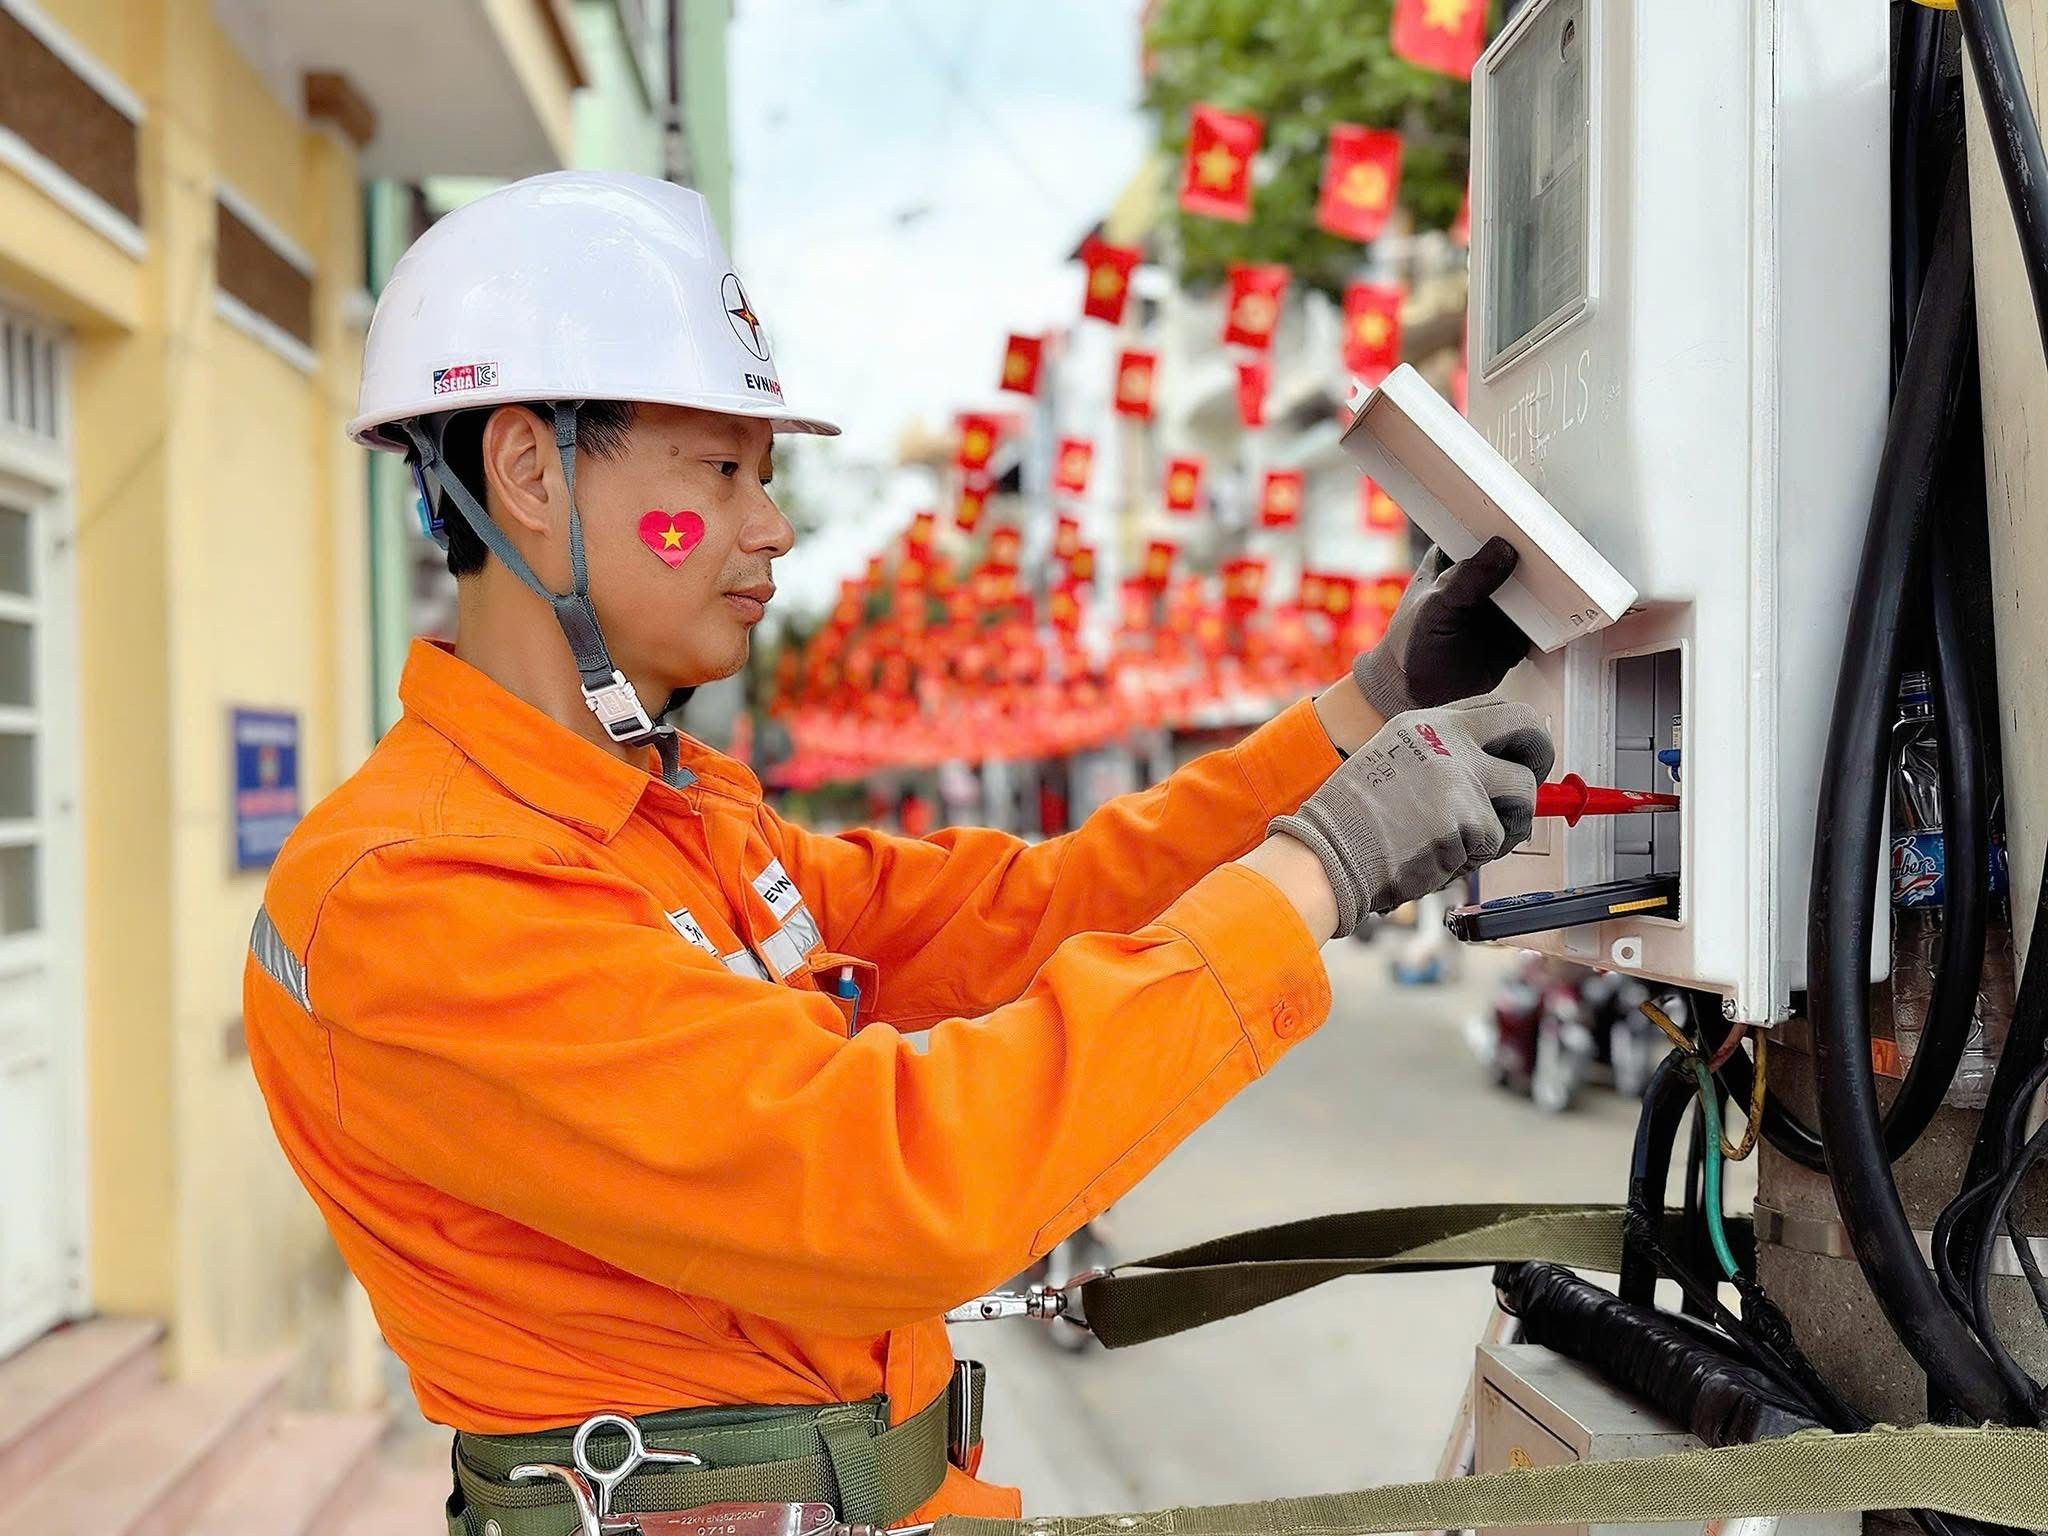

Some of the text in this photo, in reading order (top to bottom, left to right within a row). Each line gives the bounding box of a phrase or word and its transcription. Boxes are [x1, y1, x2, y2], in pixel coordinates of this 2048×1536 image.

[1388, 744, 1400, 759] L
[1397, 729, 1427, 761] Gloves
[763, 875, 792, 904] EVN
